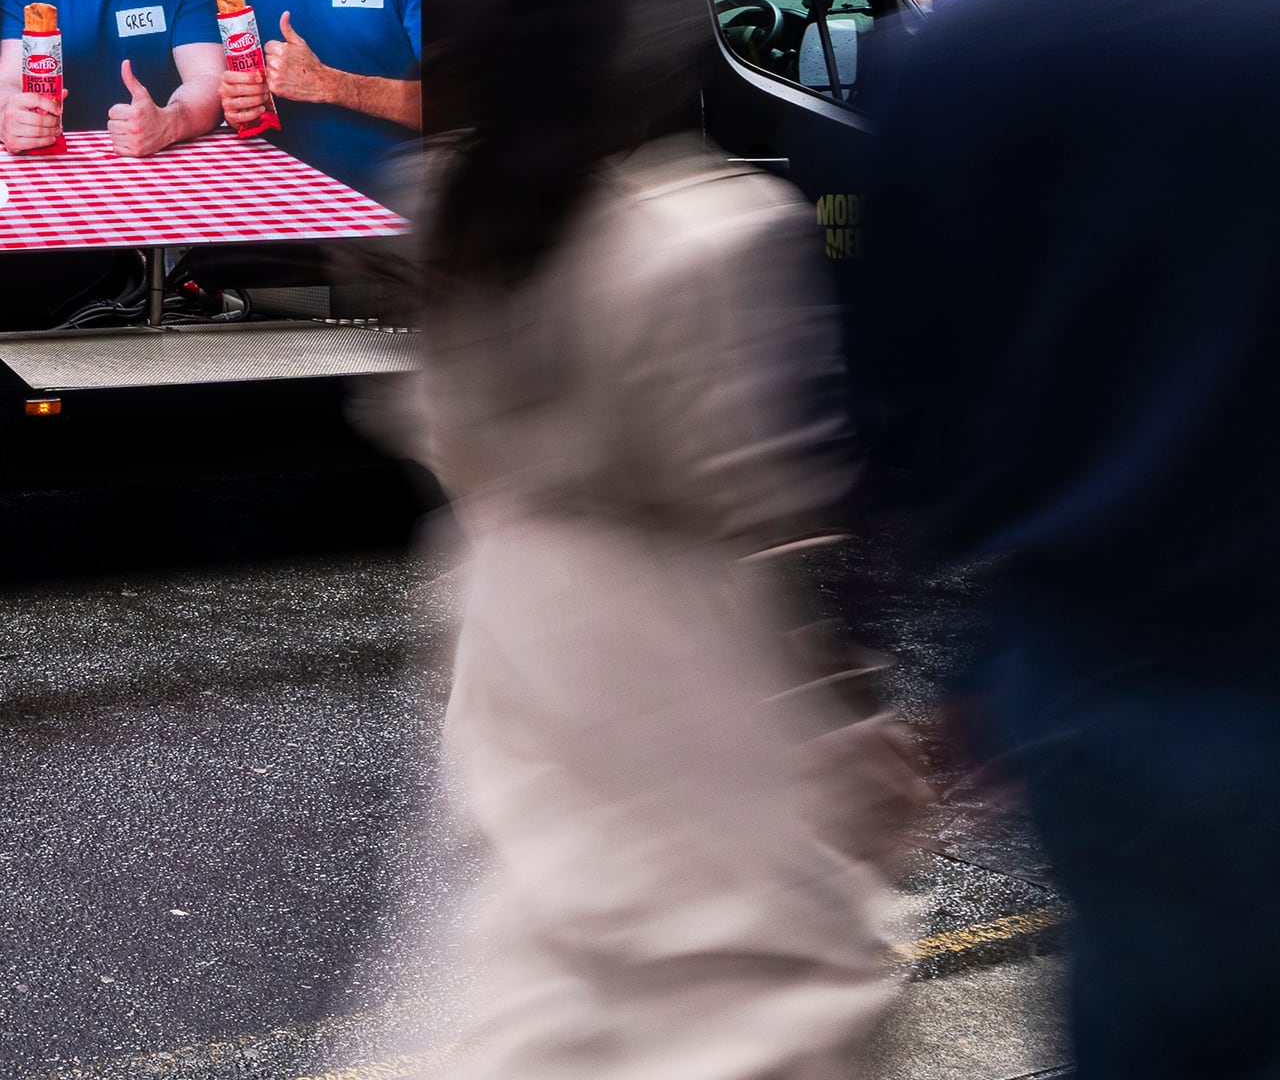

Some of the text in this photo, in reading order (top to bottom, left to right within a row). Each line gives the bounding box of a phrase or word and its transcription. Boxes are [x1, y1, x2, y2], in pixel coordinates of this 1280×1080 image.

[125, 11, 154, 30] GREG
[232, 58, 259, 71] ROLL
[27, 82, 57, 93] ROLL
